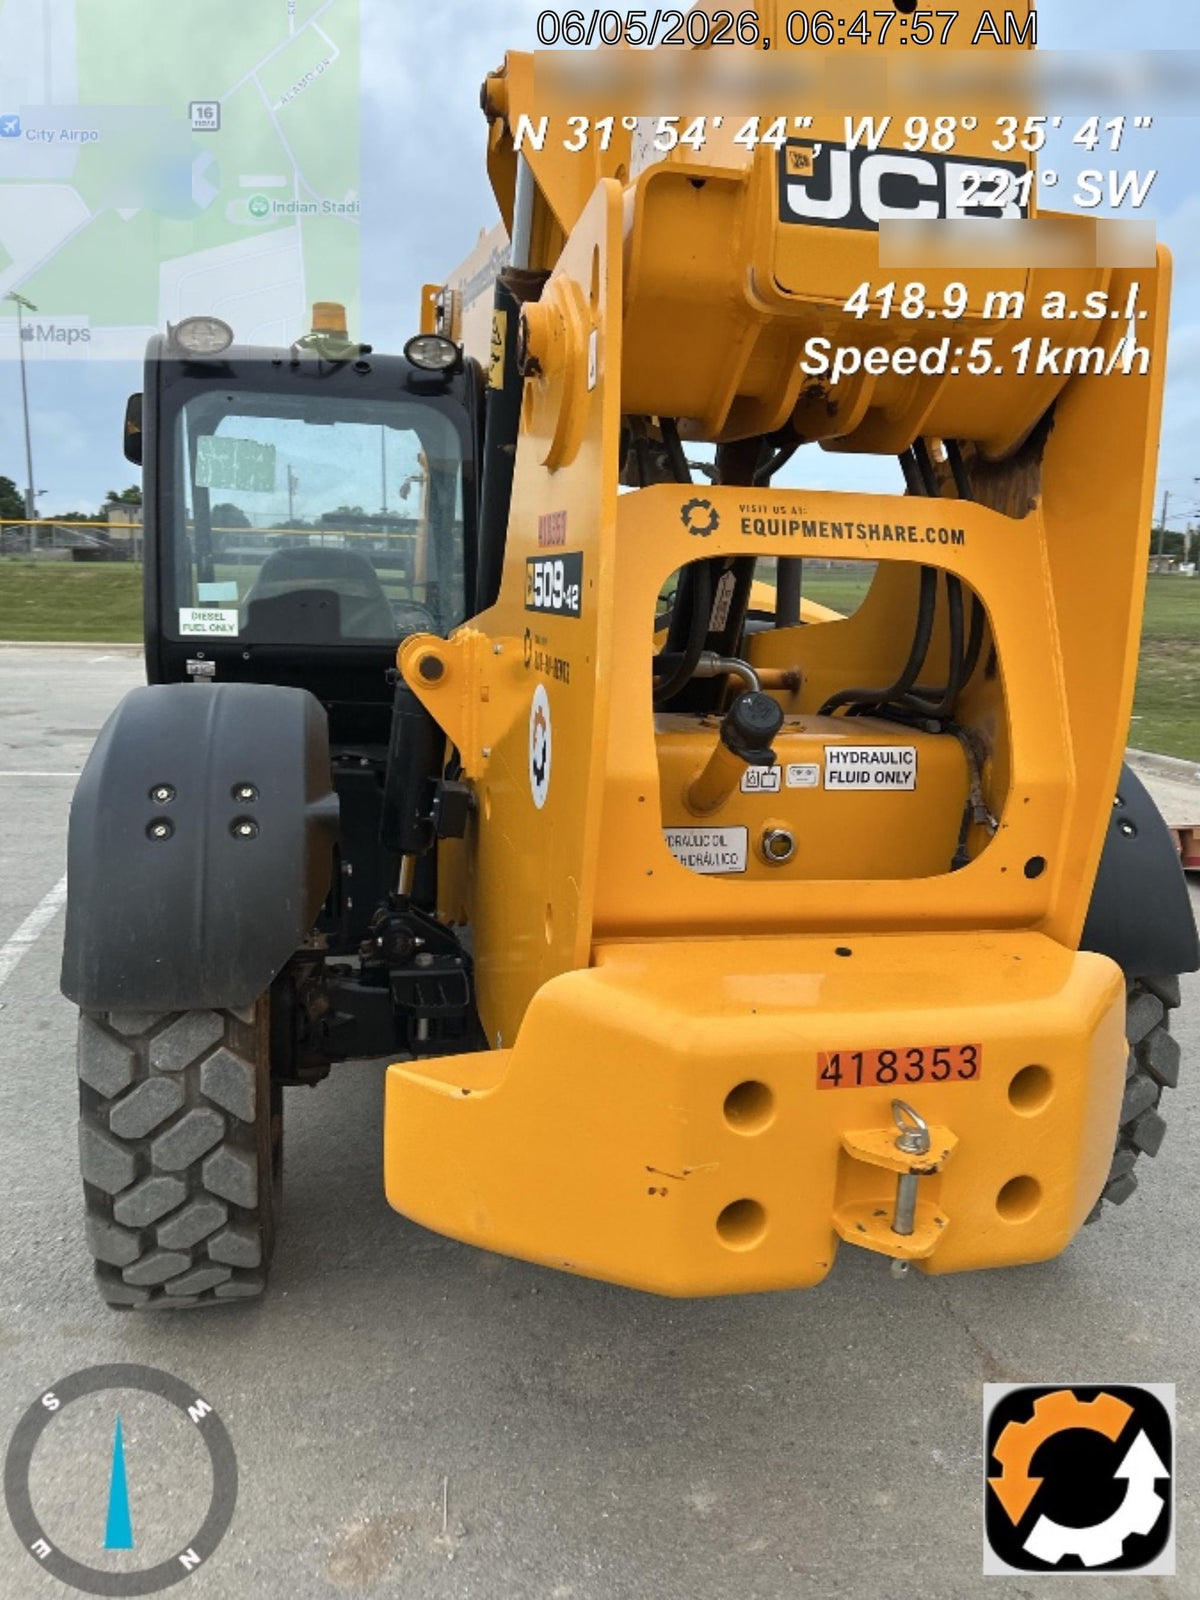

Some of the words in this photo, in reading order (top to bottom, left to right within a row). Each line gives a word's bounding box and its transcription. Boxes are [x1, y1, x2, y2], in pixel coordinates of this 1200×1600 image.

[786, 149, 1022, 222] JCB
[772, 505, 786, 514] US
[740, 517, 966, 546] EQUIPMENTSHARE.COM
[191, 611, 226, 621] DIESEL
[829, 751, 913, 765] HYDRAULIC
[829, 771, 871, 784] FLUID
[874, 771, 912, 785] ONLY
[665, 834, 710, 848] DRAULIC
[820, 1045, 977, 1087] 418353
